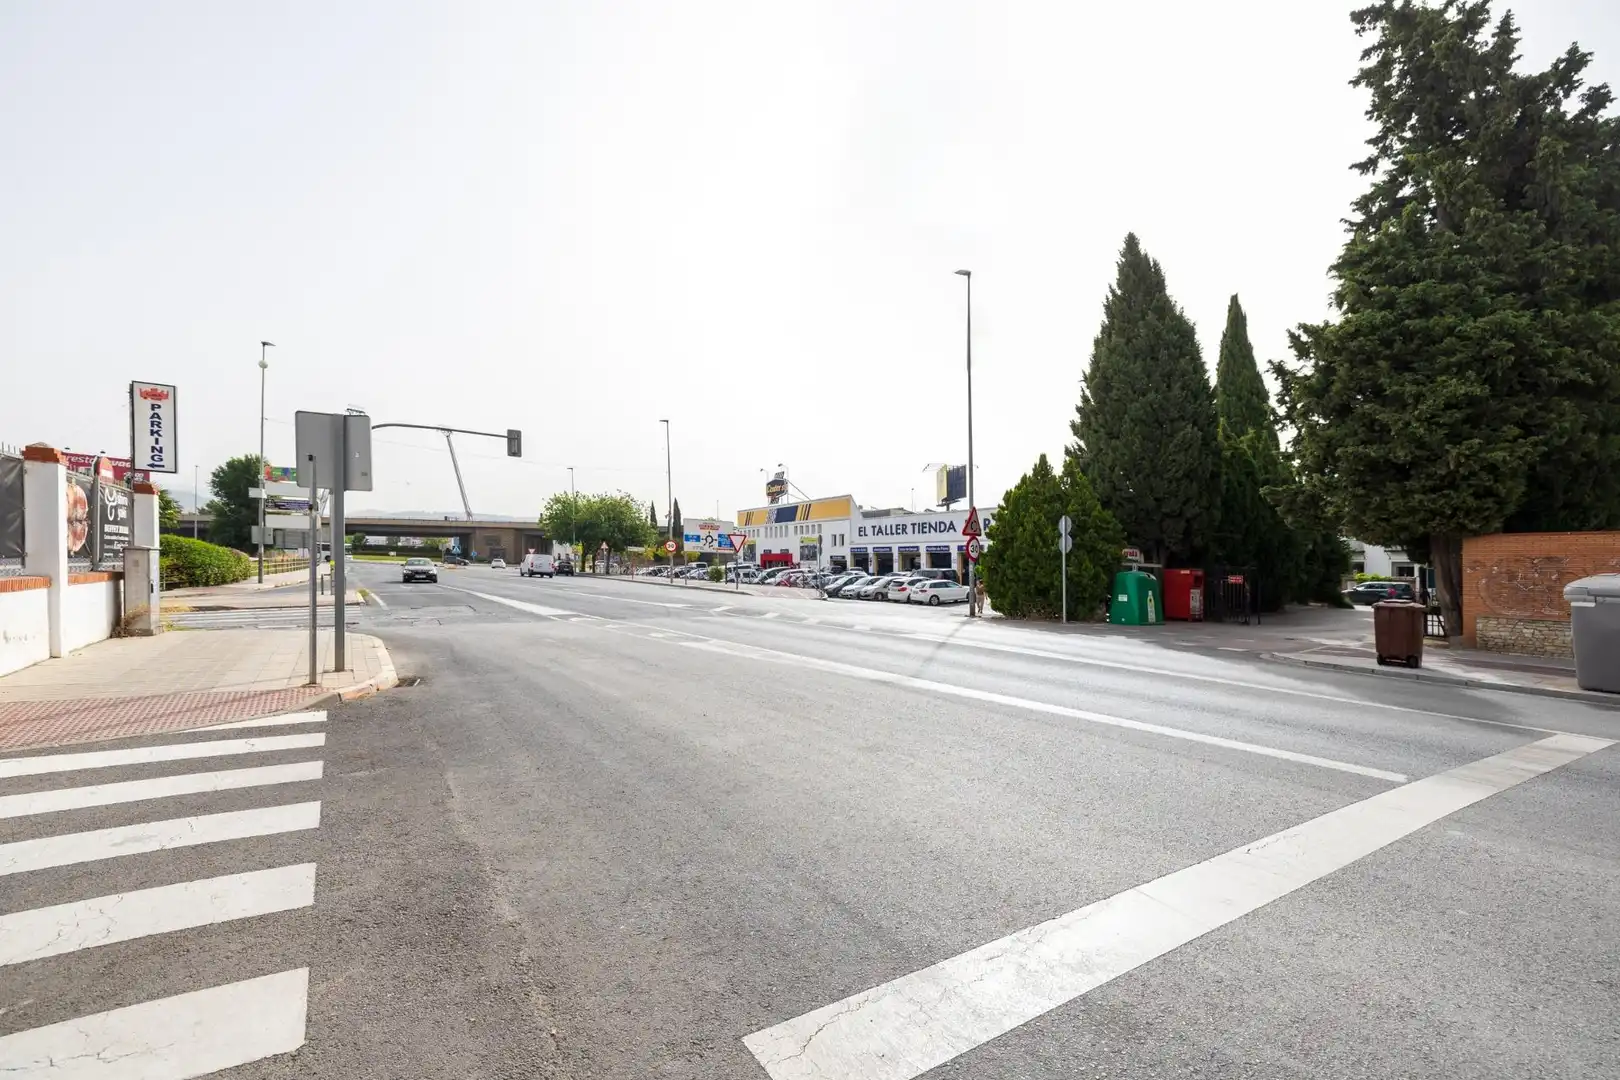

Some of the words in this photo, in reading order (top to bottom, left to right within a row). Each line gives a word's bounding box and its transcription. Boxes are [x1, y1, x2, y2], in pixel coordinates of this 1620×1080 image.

[149, 403, 164, 463] PARKING
[858, 526, 868, 537] EL
[871, 523, 908, 537] TALLER
[910, 520, 957, 535] TIENDA
[970, 544, 979, 554] 30
